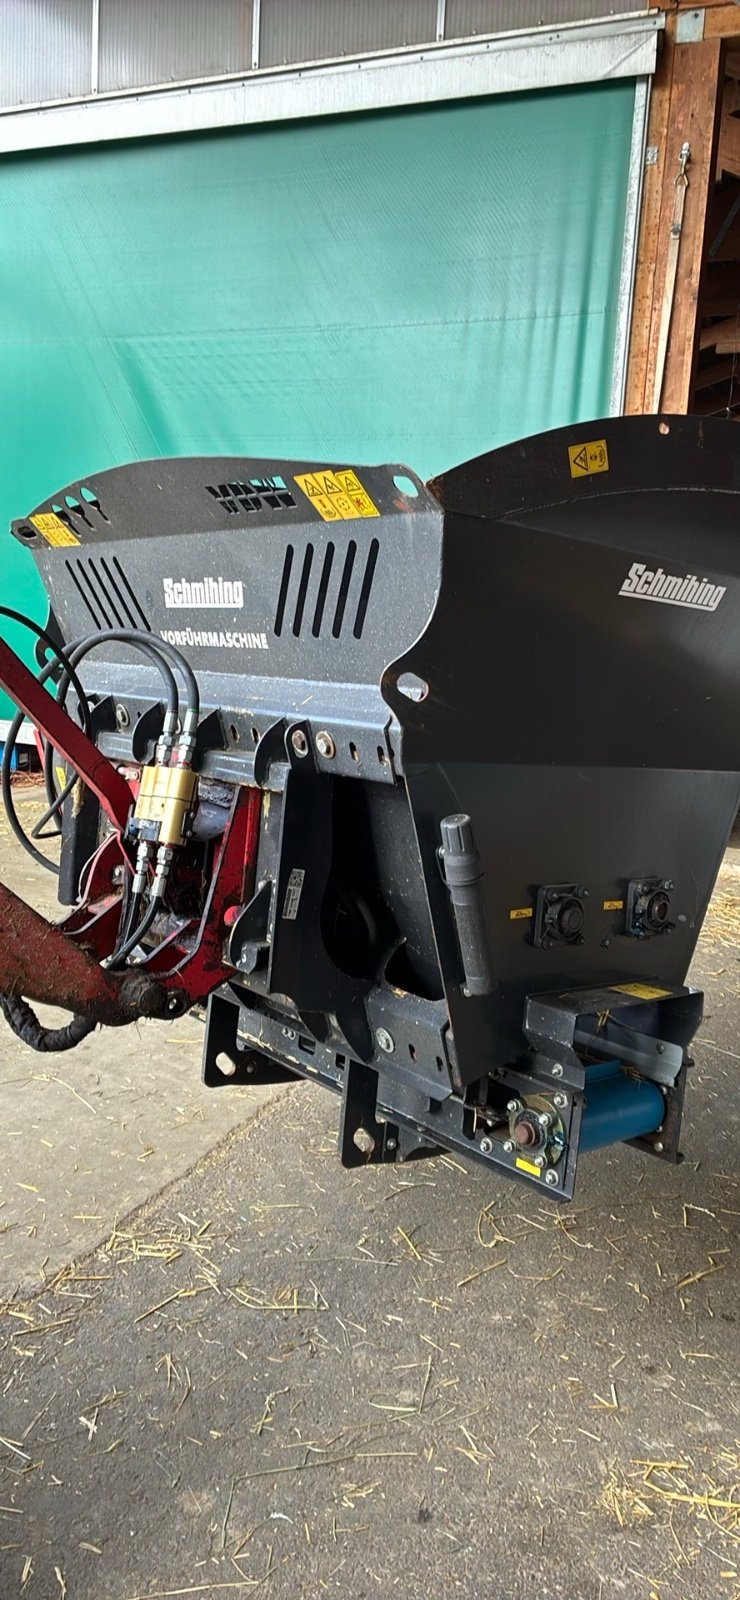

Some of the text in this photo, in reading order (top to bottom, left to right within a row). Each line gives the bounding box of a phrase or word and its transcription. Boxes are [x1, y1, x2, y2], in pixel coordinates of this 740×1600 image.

[163, 577, 244, 608] Schmihing
[618, 562, 727, 611] Schmihing
[160, 627, 269, 649] VORFÜHRMASCHINE
